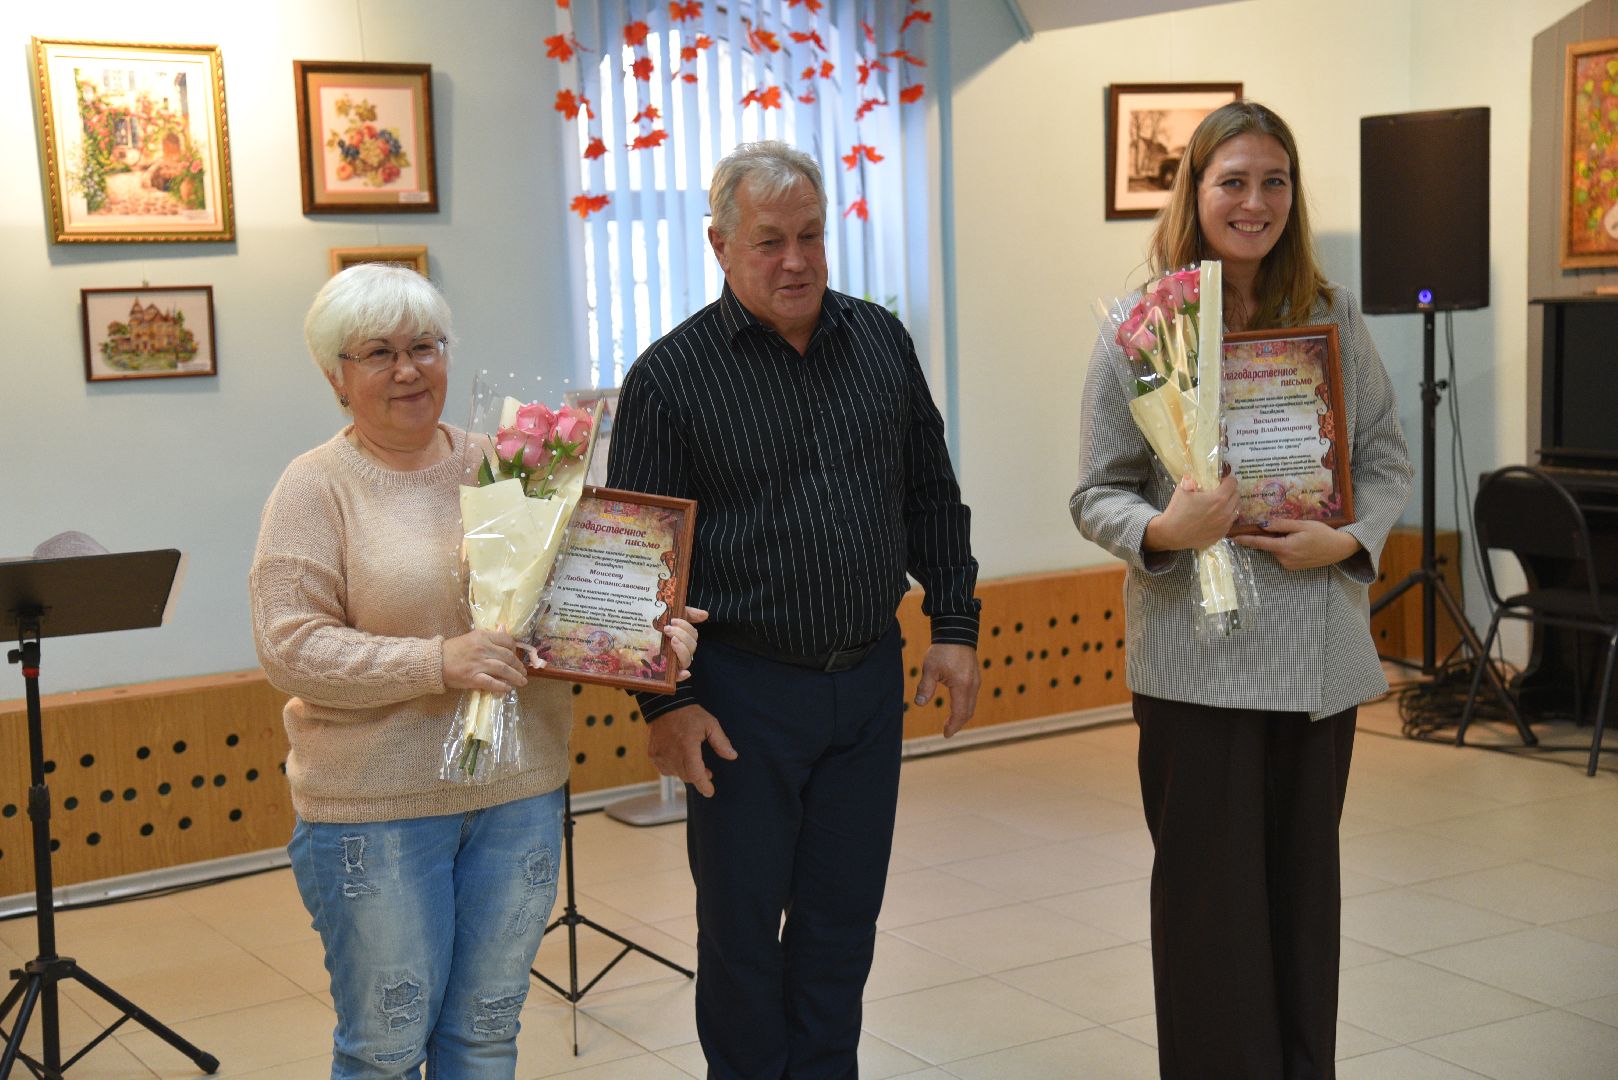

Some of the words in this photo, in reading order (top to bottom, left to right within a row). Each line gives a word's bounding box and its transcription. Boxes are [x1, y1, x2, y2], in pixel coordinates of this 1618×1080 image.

[1224, 367, 1298, 381] лагодарственное
[1281, 377, 1312, 387] письмо
[1236, 428, 1258, 436] Ирину
[1260, 424, 1312, 433] Владимировну
[570, 519, 647, 538] годарственное
[624, 538, 661, 550] письмо
[589, 568, 624, 580] Моисееву
[563, 574, 592, 584] Любовь
[593, 578, 650, 592] Станиславовну
